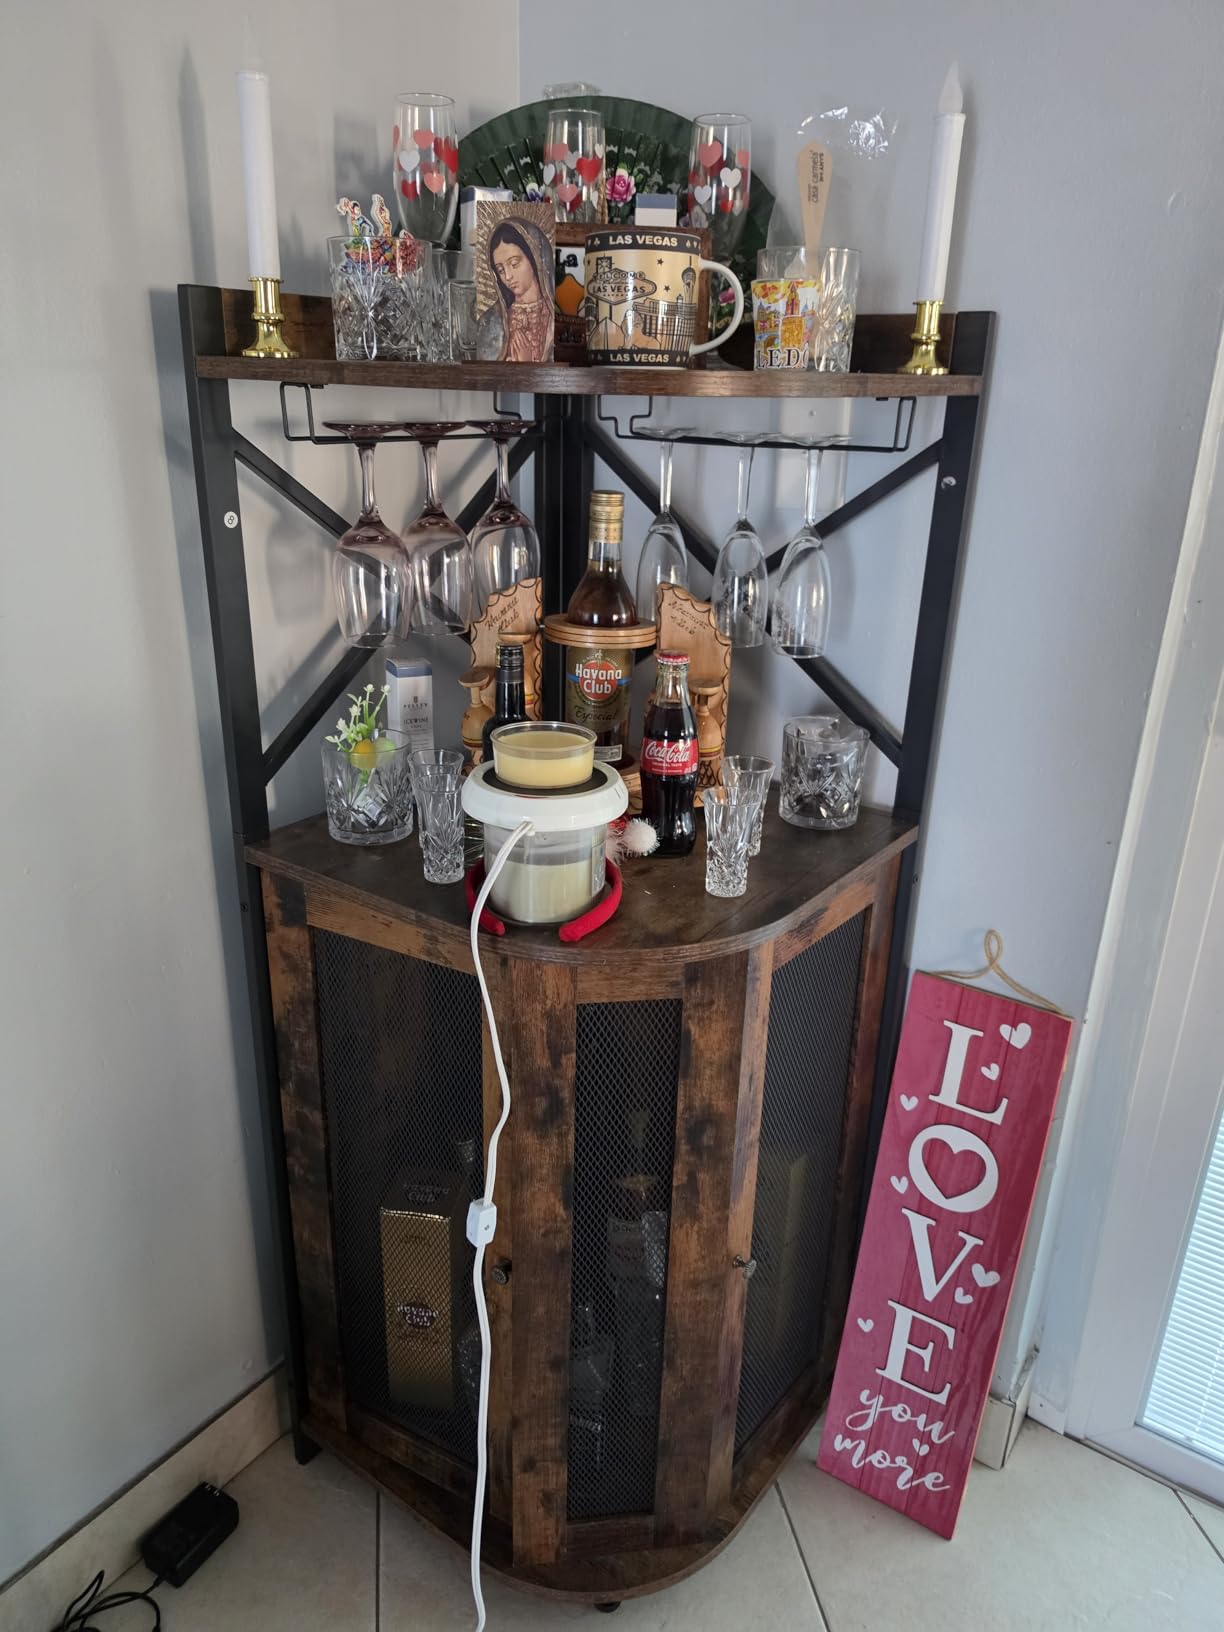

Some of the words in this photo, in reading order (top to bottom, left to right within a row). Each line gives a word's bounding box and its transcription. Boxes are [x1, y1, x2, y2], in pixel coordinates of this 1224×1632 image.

[609, 235, 633, 245] LAS
[636, 235, 678, 247] VEGAS
[592, 285, 608, 293] LAS
[610, 285, 646, 294] VEGAS
[610, 353, 630, 362] LAS
[633, 353, 670, 363] VEGAS
[575, 663, 622, 680] Havana
[583, 679, 612, 694] Club
[645, 741, 691, 763] Coca-Cola
[875, 1019, 1009, 1406] LOVE
[846, 1388, 955, 1444] you
[833, 1433, 952, 1493] more
